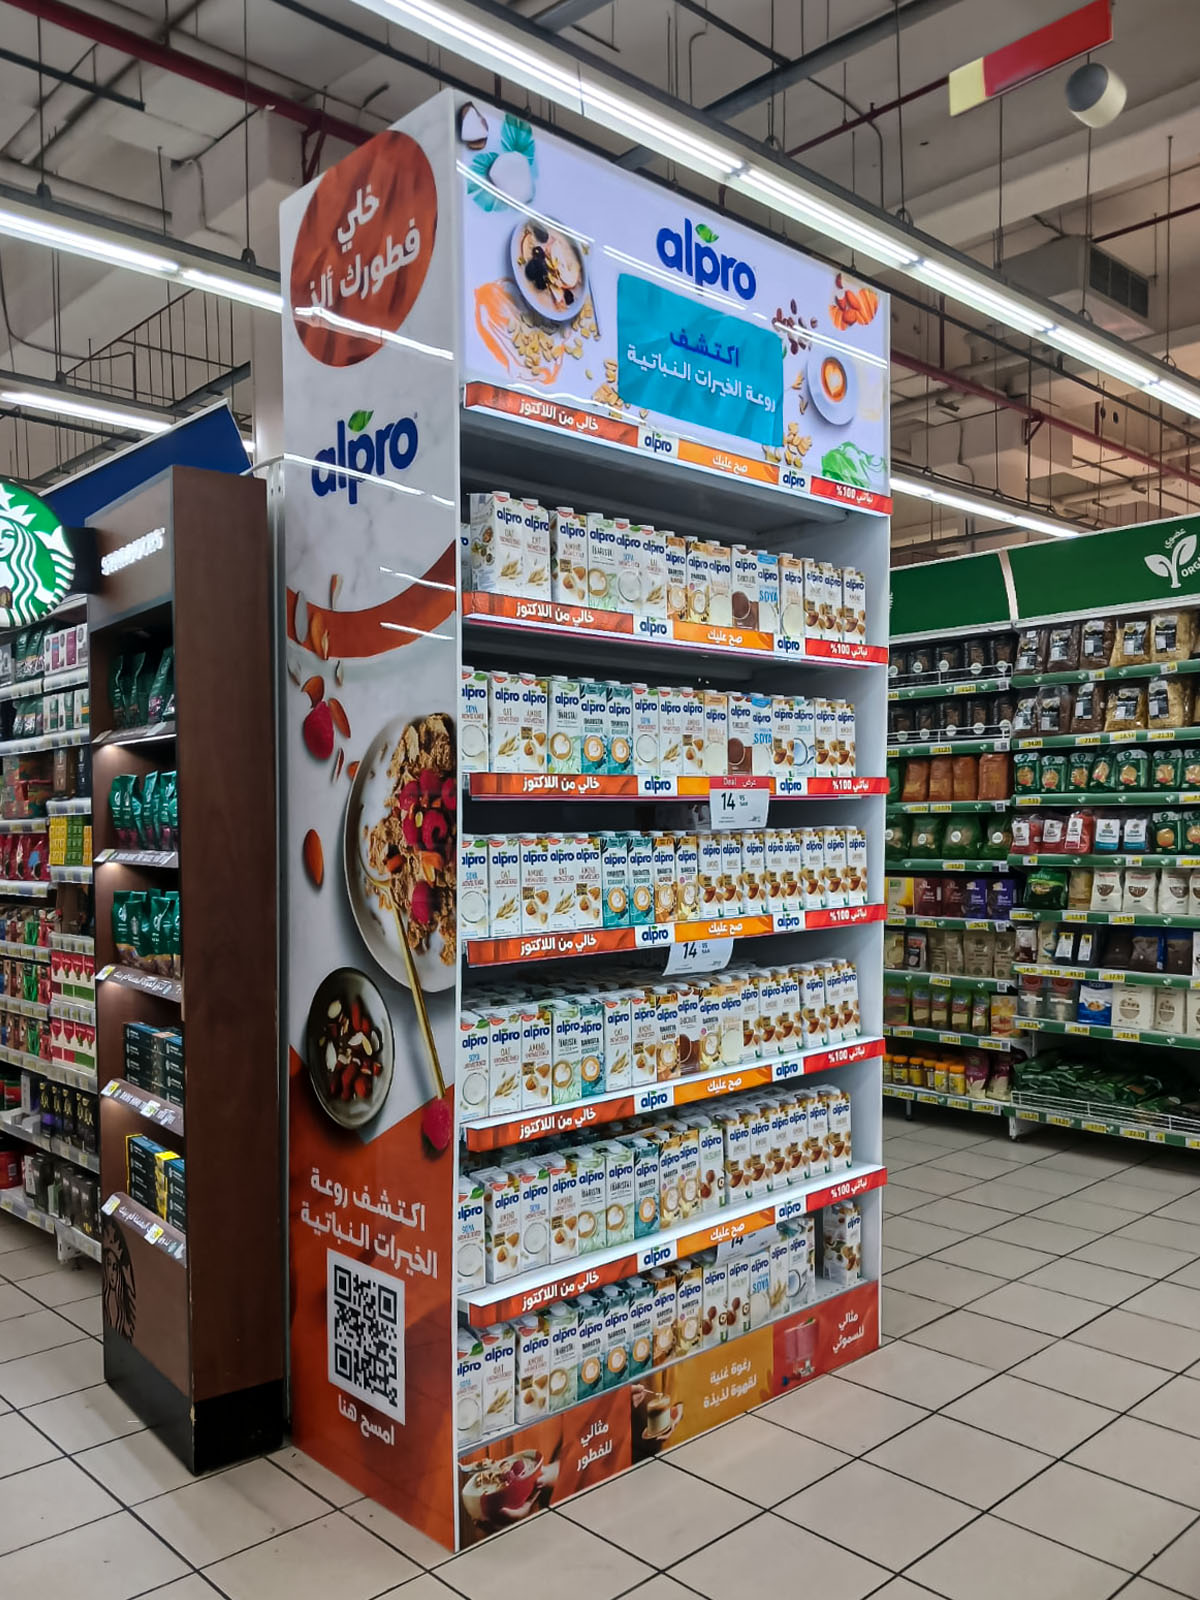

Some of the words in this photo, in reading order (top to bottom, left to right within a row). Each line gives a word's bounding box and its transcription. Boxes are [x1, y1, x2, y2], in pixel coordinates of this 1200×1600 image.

[337, 185, 379, 252] خلي
[340, 218, 420, 300] فطورك
[656, 218, 756, 300] alpro
[670, 329, 739, 367] اكتشف
[627, 344, 690, 381] النباتية
[695, 369, 741, 398] الخيرات
[746, 386, 776, 412] روعة
[519, 399, 555, 420] اللاكتوز
[558, 408, 574, 425] من
[576, 411, 598, 432] خالي
[644, 435, 672, 452] alpro
[311, 413, 418, 503] alpro
[712, 454, 731, 465] عليك
[733, 464, 748, 473] صح
[783, 472, 805, 488] alpro
[856, 490, 873, 504] نباتي
[496, 508, 522, 525] alpro
[560, 524, 585, 538] alpro
[590, 530, 615, 545] alpro
[616, 535, 640, 549] alpro
[643, 541, 665, 555] alpro
[709, 561, 730, 573] alpro
[735, 559, 757, 571] alpro
[516, 603, 552, 618] اللاكتوز
[555, 610, 569, 621] من
[572, 609, 594, 626] خالي
[640, 617, 667, 636] alpro
[707, 631, 726, 642] عليك
[728, 635, 743, 646] صح
[778, 638, 800, 653] alpro
[851, 645, 867, 658] نباتي
[495, 689, 519, 702] alpro
[523, 692, 546, 706] alpro
[555, 693, 579, 707] alpro
[582, 701, 605, 714] alpro
[608, 704, 630, 716] alpro
[635, 699, 657, 713] alpro
[523, 775, 558, 791] اللاكتوز
[561, 777, 575, 790] من
[578, 776, 600, 794] خالي
[644, 776, 671, 793] alpro
[780, 780, 801, 794] alpro
[853, 780, 869, 792] نباتي
[721, 792, 735, 810] 14
[492, 854, 518, 867] alpro
[523, 852, 547, 865] alpro
[550, 851, 574, 864] alpro
[577, 850, 599, 863] alpro
[604, 855, 626, 867] alpro
[630, 853, 651, 866] alpro
[778, 915, 799, 930] alpro
[851, 909, 867, 921] نباتي
[642, 927, 668, 943] alpro
[708, 924, 726, 934] عليك
[728, 923, 743, 935] صح
[520, 937, 555, 956] اللاكتوز
[558, 938, 573, 950] من
[575, 934, 597, 952] خالي
[683, 942, 697, 959] 14
[678, 1001, 698, 1013] alpro
[608, 1013, 629, 1026] alpro
[634, 1009, 655, 1022] alpro
[657, 1009, 677, 1023] alpro
[524, 1027, 549, 1040] alpro
[557, 1022, 579, 1035] alpro
[462, 1036, 487, 1050] alpro
[492, 1031, 520, 1045] alpro
[776, 1063, 798, 1077] alpro
[707, 1080, 726, 1092] عليك
[727, 1078, 742, 1091] صح
[641, 1092, 667, 1109] alpro
[557, 1114, 572, 1130] من
[575, 1108, 596, 1128] خالي
[520, 1117, 555, 1140] اللاكتوز
[701, 1137, 722, 1149] alpro
[609, 1165, 632, 1178] alpro
[637, 1164, 657, 1178] alpro
[552, 1179, 577, 1193] alpro
[579, 1173, 604, 1186] alpro
[851, 1180, 867, 1193] نباتي
[310, 1168, 348, 1208] روعة
[523, 1187, 547, 1200] alpro
[353, 1186, 426, 1232] اكتشف
[495, 1195, 519, 1209] alpro
[779, 1202, 801, 1218] alpro
[300, 1201, 370, 1250] النباتية
[729, 1222, 745, 1237] صح
[710, 1228, 729, 1241] عليك
[374, 1234, 438, 1280] الخيرات
[644, 1248, 670, 1265] alpro
[578, 1272, 599, 1291] خالي
[705, 1272, 725, 1286] alpro
[560, 1282, 574, 1297] من
[679, 1284, 701, 1299] alpro
[522, 1286, 557, 1311] اللاكتوز
[631, 1304, 652, 1319] alpro
[605, 1313, 628, 1328] alpro
[839, 1309, 858, 1331] مثالي
[553, 1329, 577, 1344] alpro
[579, 1323, 602, 1338] alpro
[523, 1339, 549, 1354] alpro
[485, 1348, 513, 1362] alpro
[457, 1362, 481, 1377] lpro
[338, 1395, 357, 1422] هنا
[360, 1414, 394, 1446] امسح
[581, 1419, 608, 1445] مثالي
[577, 1440, 612, 1472] للفطور
